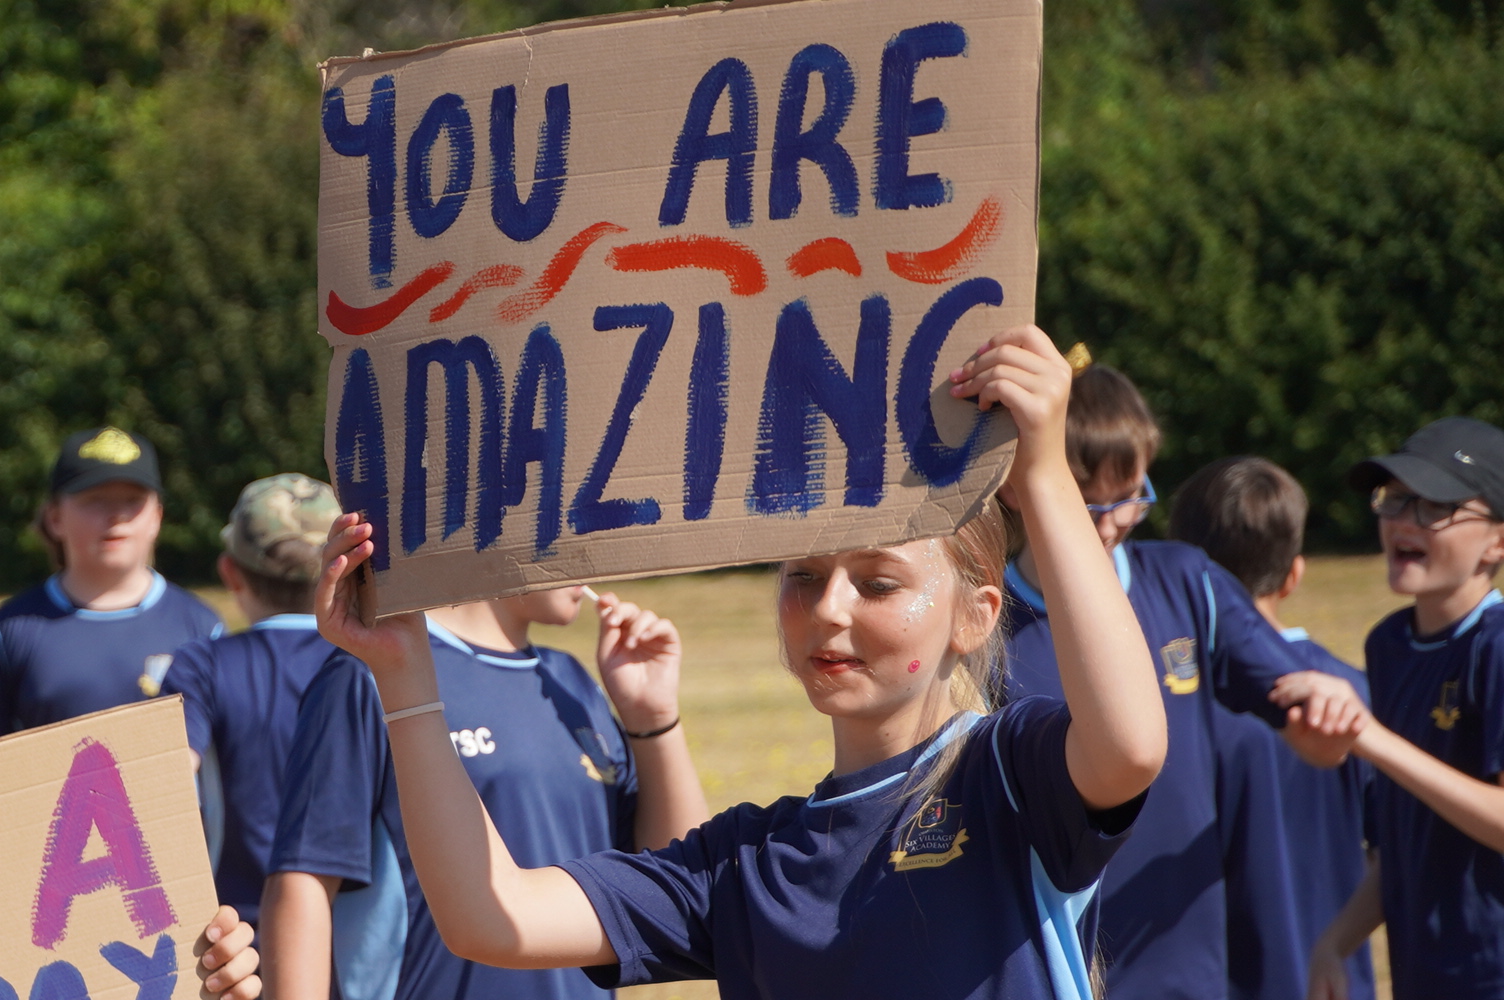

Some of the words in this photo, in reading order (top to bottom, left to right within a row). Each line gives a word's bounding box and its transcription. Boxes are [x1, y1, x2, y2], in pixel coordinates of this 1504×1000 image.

[322, 75, 570, 288] YOU
[659, 21, 969, 228] ARE
[335, 277, 1004, 572] AMAZING
